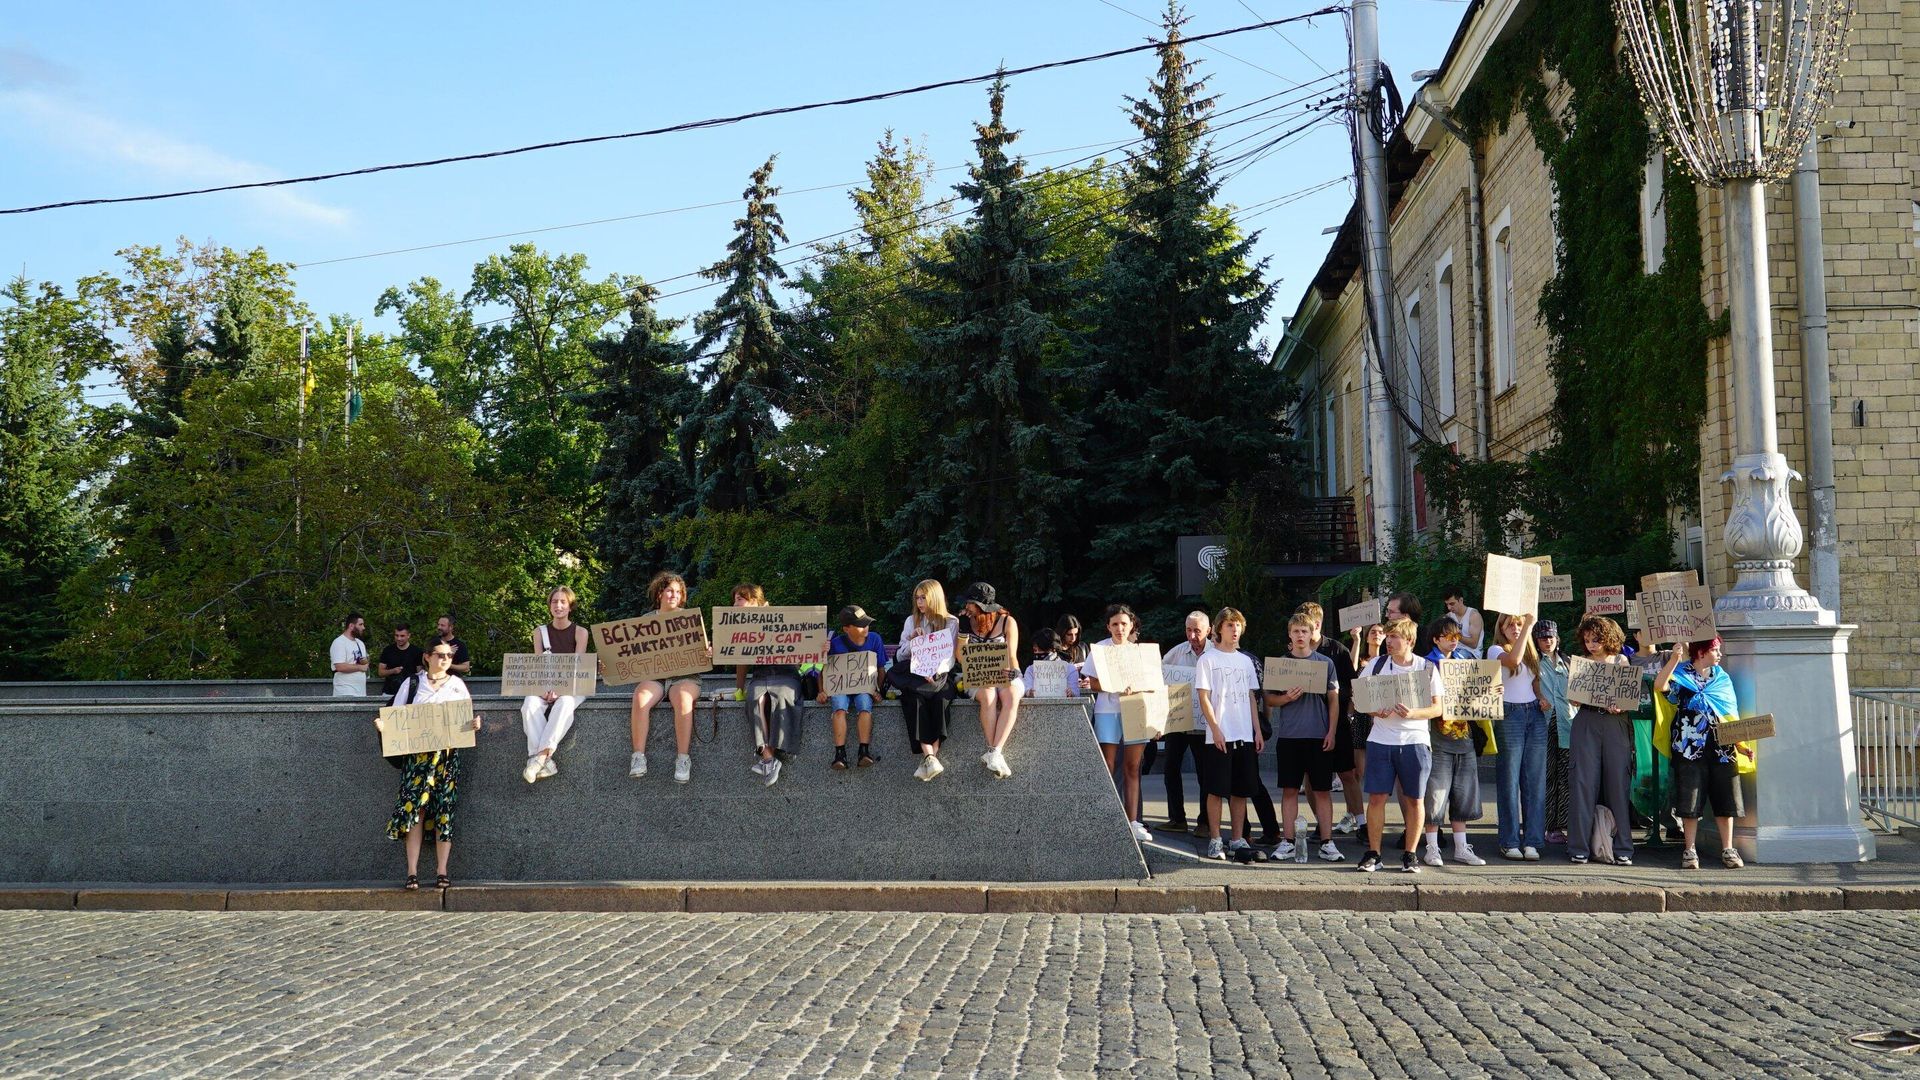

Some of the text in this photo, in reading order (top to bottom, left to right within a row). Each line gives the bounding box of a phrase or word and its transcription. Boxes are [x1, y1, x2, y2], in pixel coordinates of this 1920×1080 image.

[1587, 588, 1622, 597] ЗМІНИМОСЬ
[1641, 590, 1687, 604] ЕПОХА
[1589, 604, 1622, 614] ЗАГИНЕМО
[631, 620, 661, 638] ХТО
[665, 614, 702, 633] ПРОТИ
[1647, 614, 1690, 627] ЕПОХА
[775, 633, 802, 643] САП
[720, 645, 795, 656] ЦЕ ШЛЯХ ДО
[962, 646, 968, 655] Я
[615, 647, 708, 680] ВСТАНЬТЕ
[826, 656, 840, 672] ЯК
[847, 652, 868, 671] ВИ
[566, 671, 590, 679] СКЛЬКИ
[1443, 661, 1480, 677] ГОВЕРЛА
[1576, 660, 1638, 679] НАХУЯ МЕНІ
[1573, 671, 1638, 689] СИСТЕМА ЩО
[1462, 686, 1480, 696] ХТО
[1481, 686, 1493, 696] НЕ
[1570, 680, 1640, 700] ПРАЦЮЄ ПРОТИ
[1447, 705, 1459, 717] НЕ
